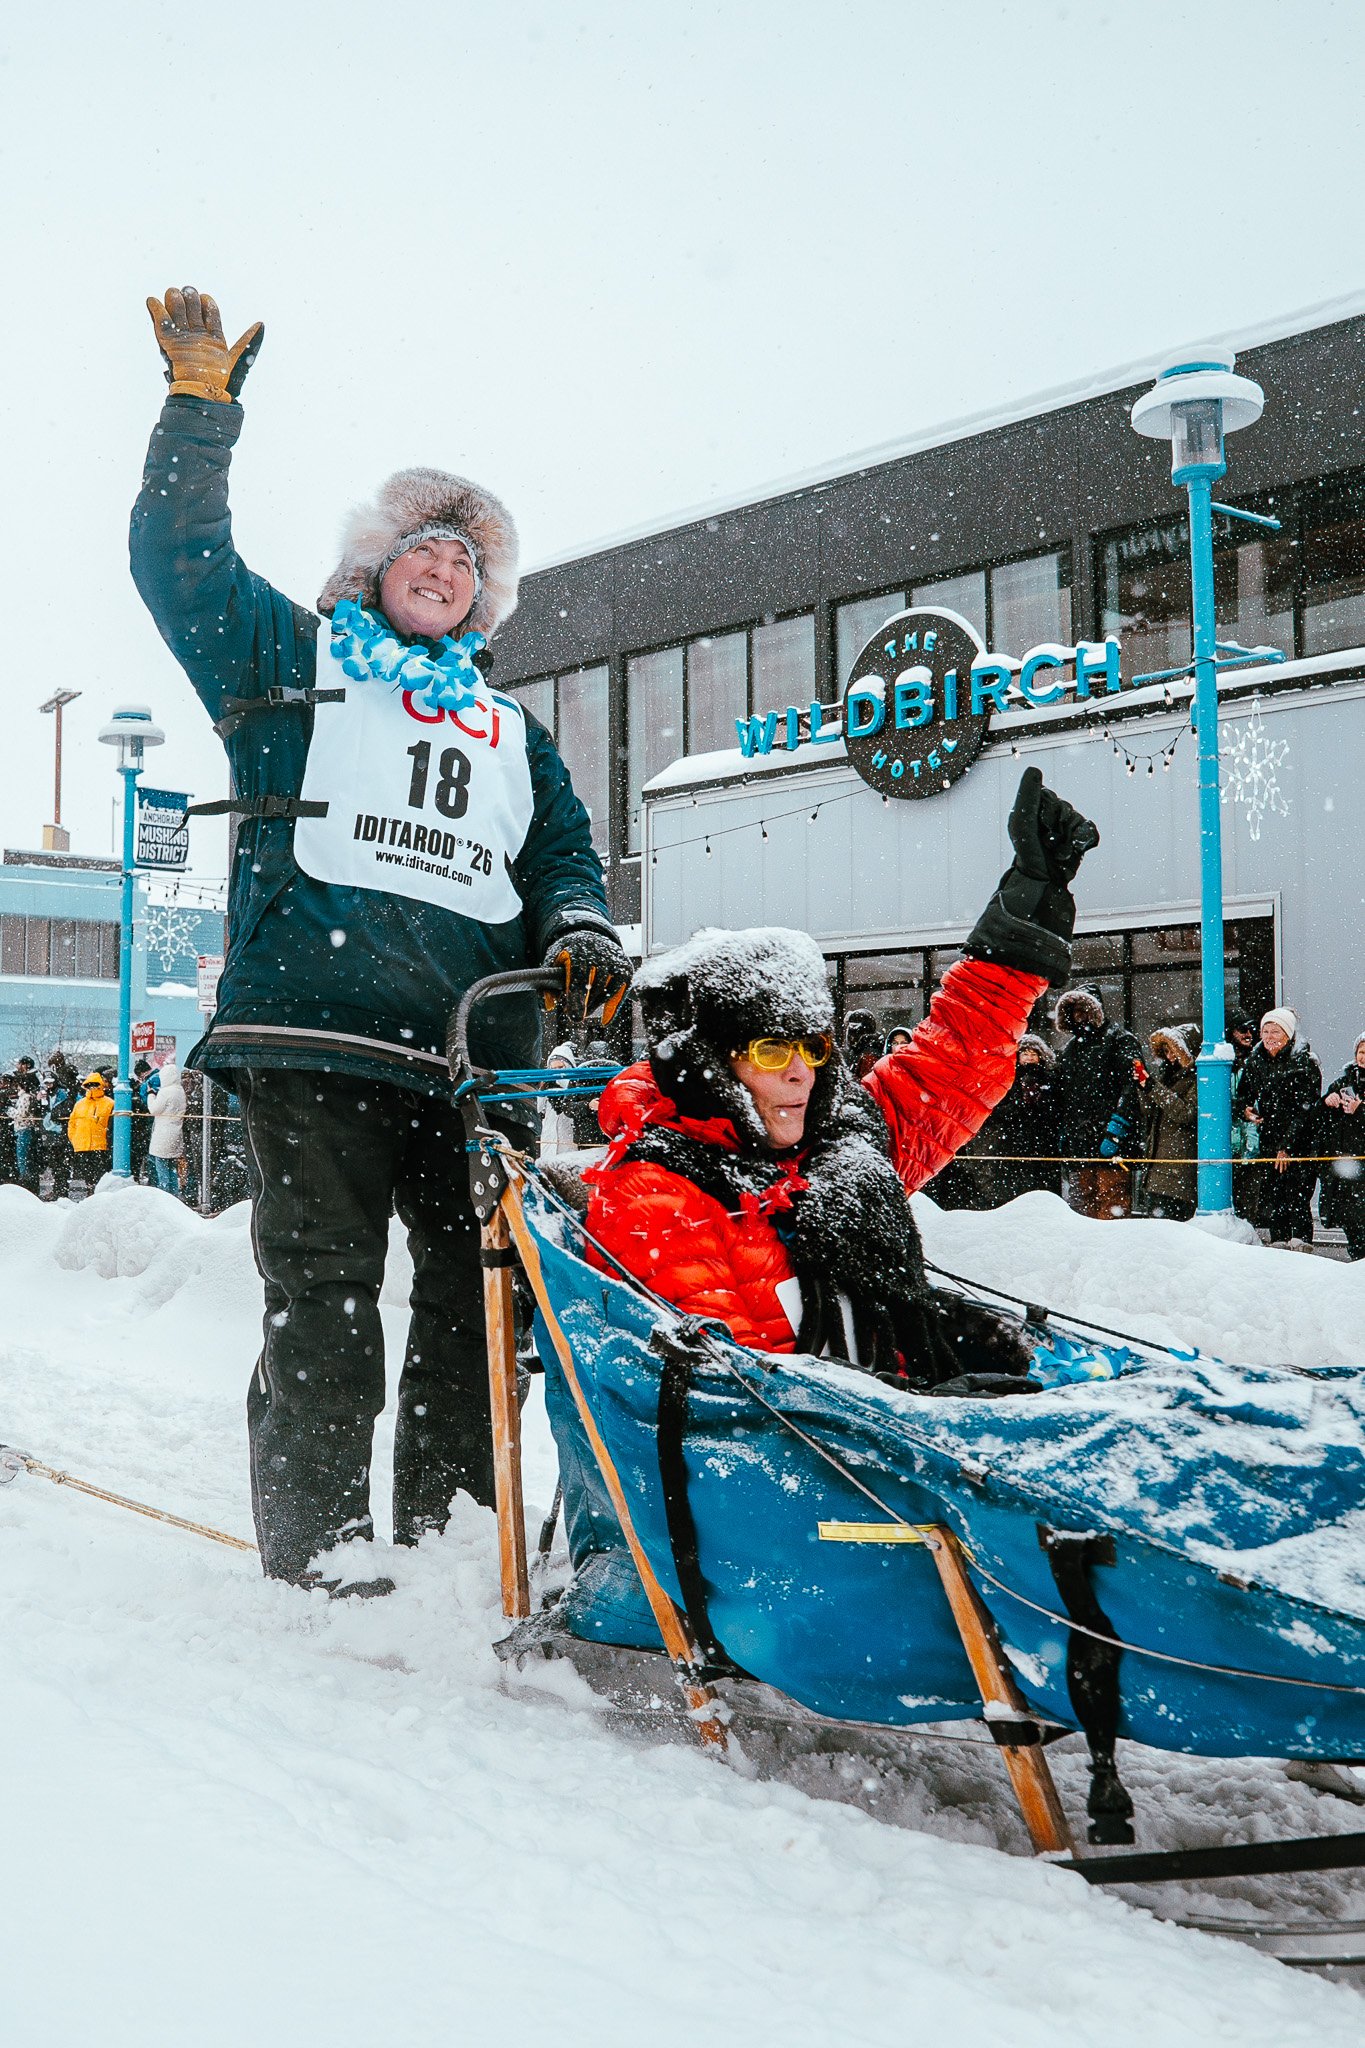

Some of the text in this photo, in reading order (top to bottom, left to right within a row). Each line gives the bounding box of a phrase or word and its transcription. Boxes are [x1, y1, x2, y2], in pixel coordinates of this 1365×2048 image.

[884, 630, 938, 660] THE
[735, 635, 1122, 758] WILDBIRCH
[871, 738, 958, 779] HOTEL
[406, 739, 472, 820] 18
[138, 842, 187, 862] DISTRICT
[139, 824, 188, 846] MUSHING
[375, 850, 473, 887] www.iditarod.com
[466, 839, 493, 876] '26
[136, 1037, 149, 1048] WAY
